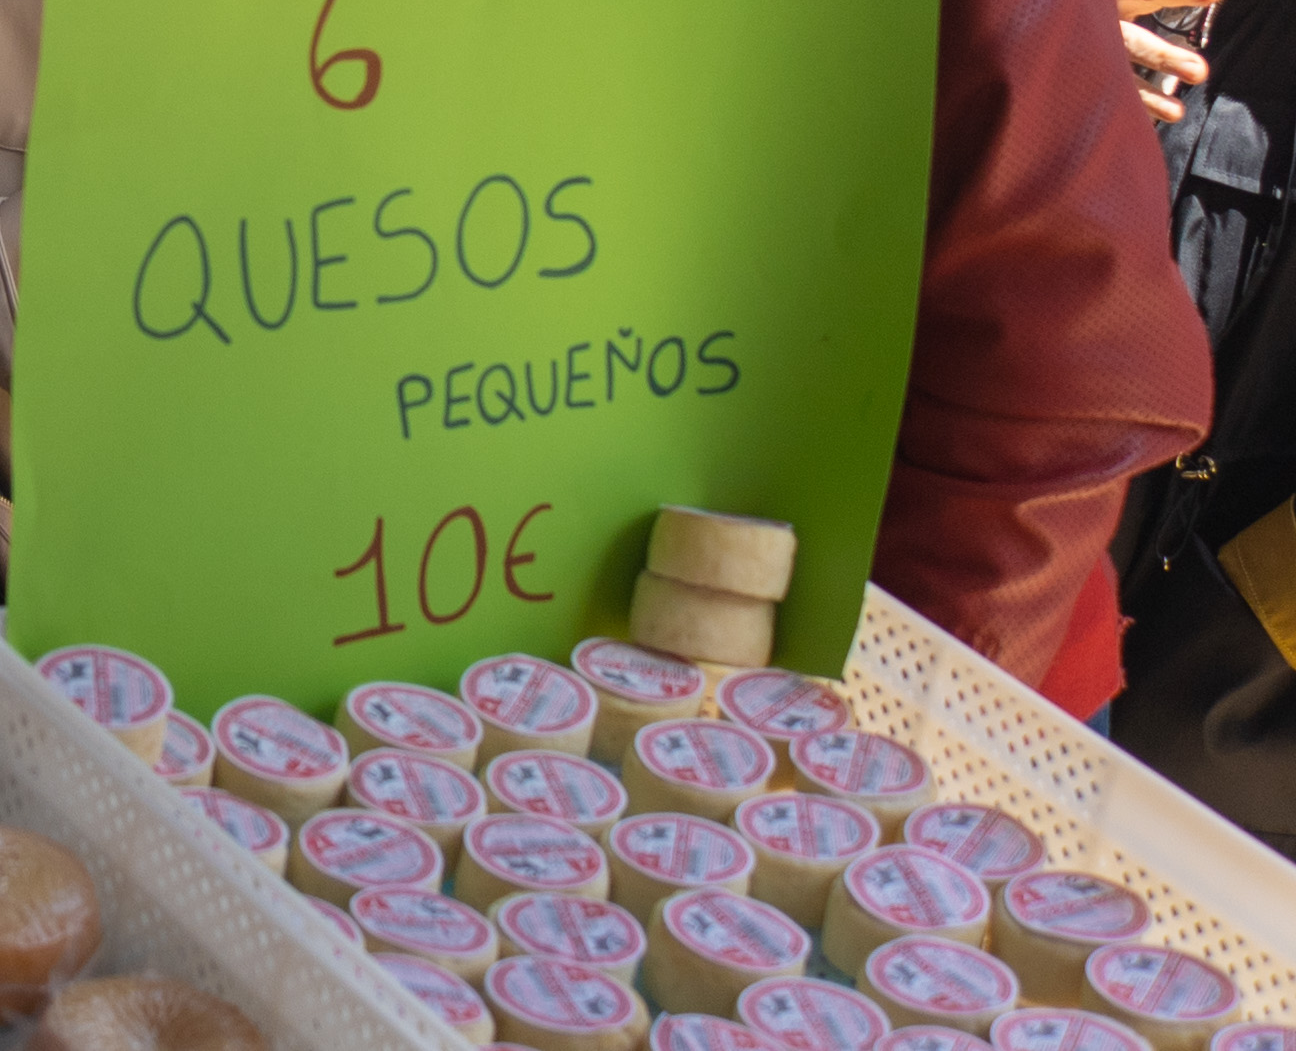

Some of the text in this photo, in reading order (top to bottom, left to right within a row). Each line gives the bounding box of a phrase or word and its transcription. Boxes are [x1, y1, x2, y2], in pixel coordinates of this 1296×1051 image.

[132, 174, 598, 346] QUESOS
[396, 328, 741, 439] PEQUEÑOS
[332, 504, 555, 647] 10€
